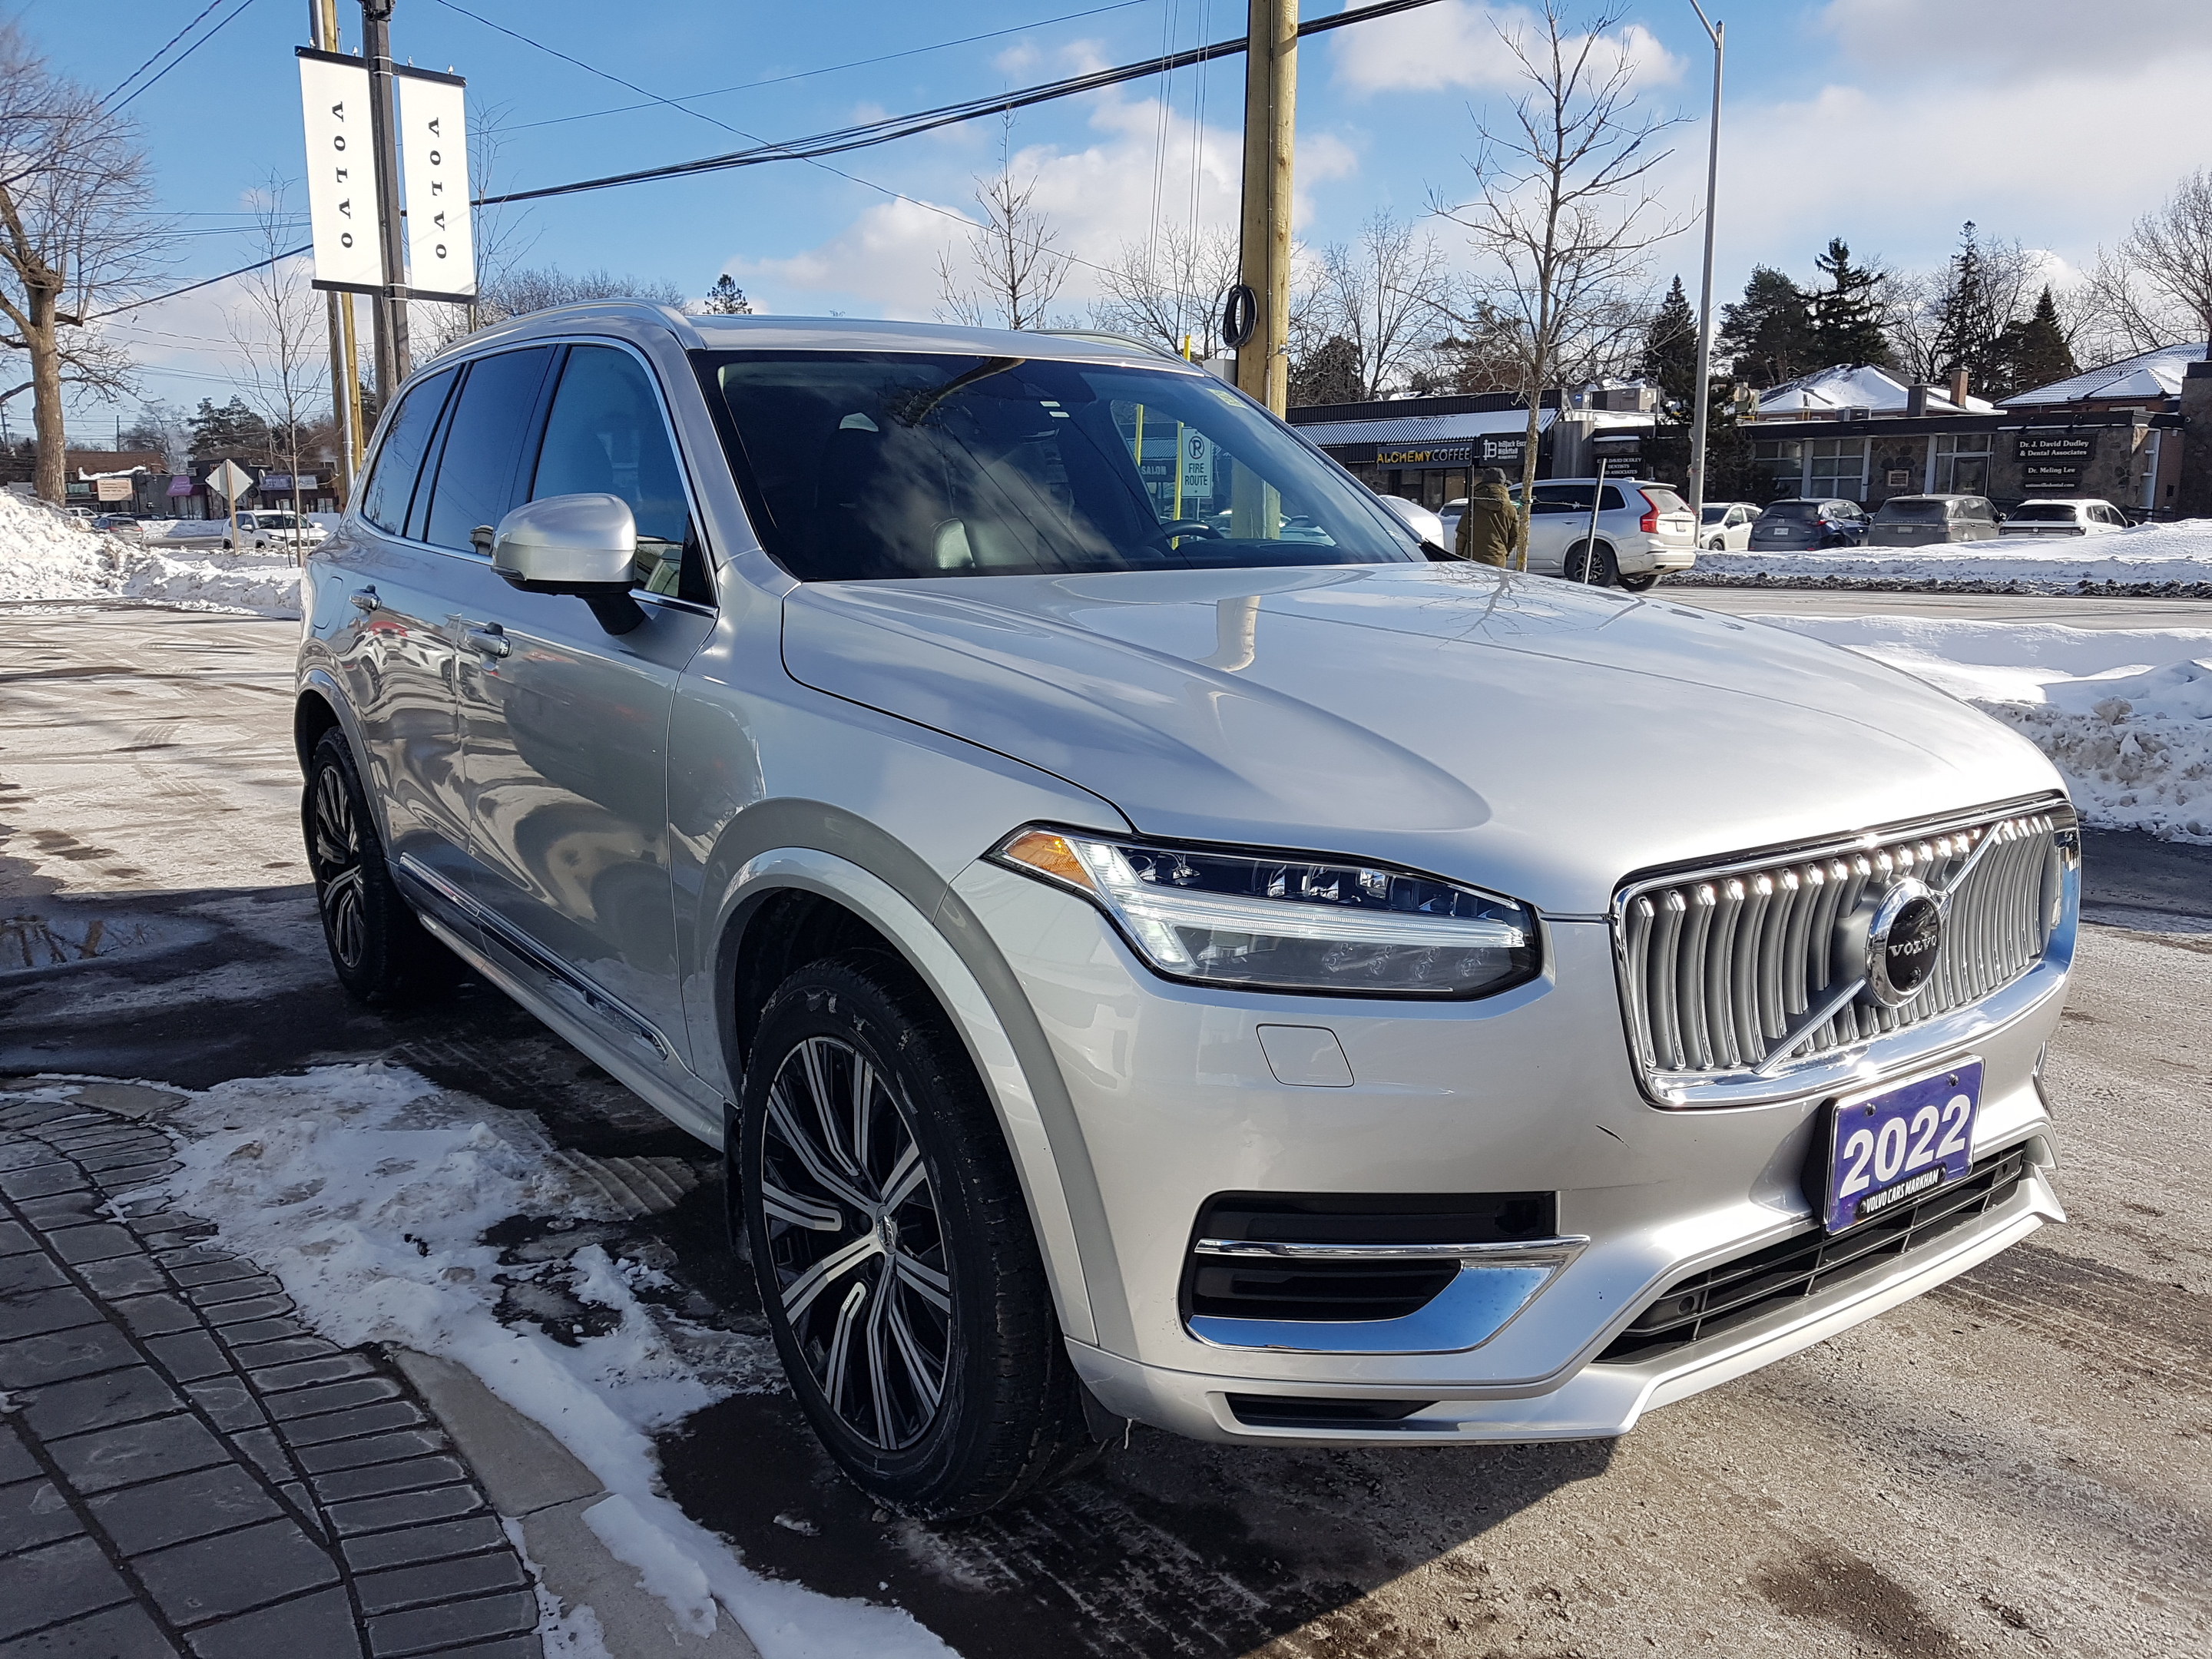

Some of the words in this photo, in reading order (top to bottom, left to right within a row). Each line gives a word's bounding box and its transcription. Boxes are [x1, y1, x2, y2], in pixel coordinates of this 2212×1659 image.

[332, 101, 353, 248] VOLVO
[428, 117, 447, 259] VOLVO
[2063, 439, 2089, 448] Dudley
[1141, 465, 1167, 475] SALON
[1188, 463, 1204, 473] FIRE
[1184, 475, 1208, 485] ROUTE
[1889, 935, 1937, 957] VOLVO
[1839, 1094, 1971, 1199] 2022
[1866, 1190, 1887, 1214] VOLVO
[1887, 1183, 1906, 1204] CARS
[1905, 1169, 1940, 1196] MARKHAM
